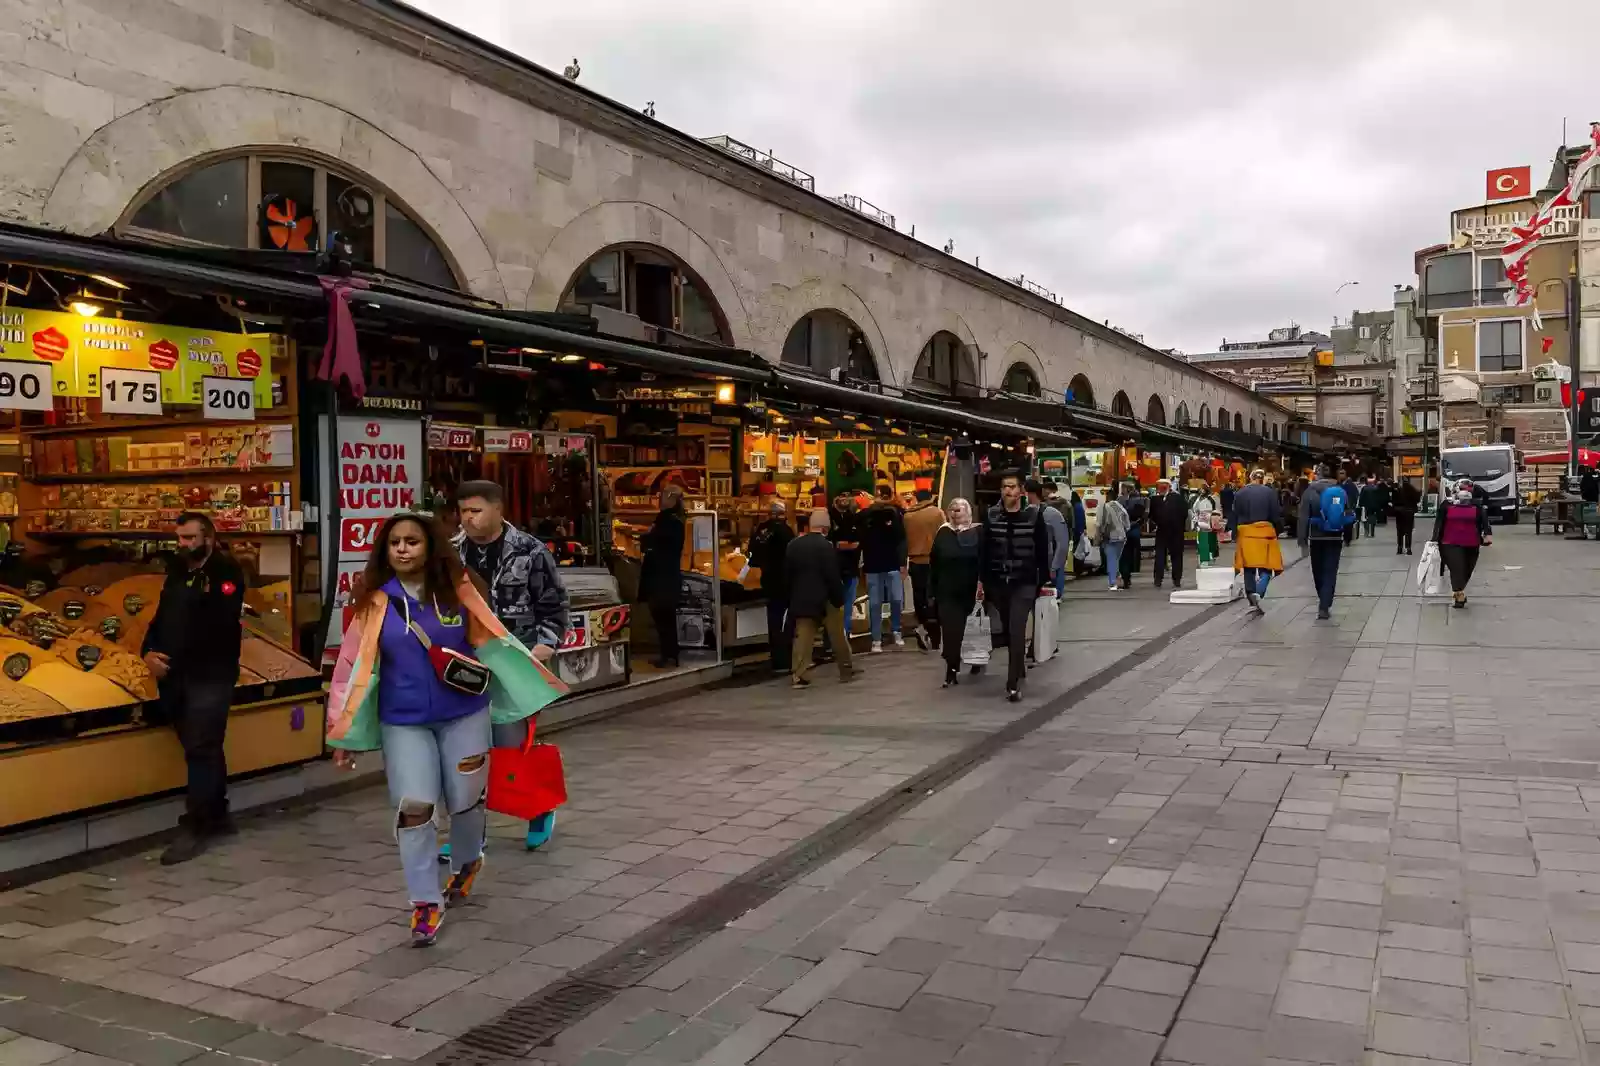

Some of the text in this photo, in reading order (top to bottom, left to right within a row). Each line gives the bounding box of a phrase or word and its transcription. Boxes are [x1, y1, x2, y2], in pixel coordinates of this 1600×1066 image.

[106, 379, 157, 403] 175
[208, 389, 250, 410] 200
[342, 463, 408, 484] DANA
